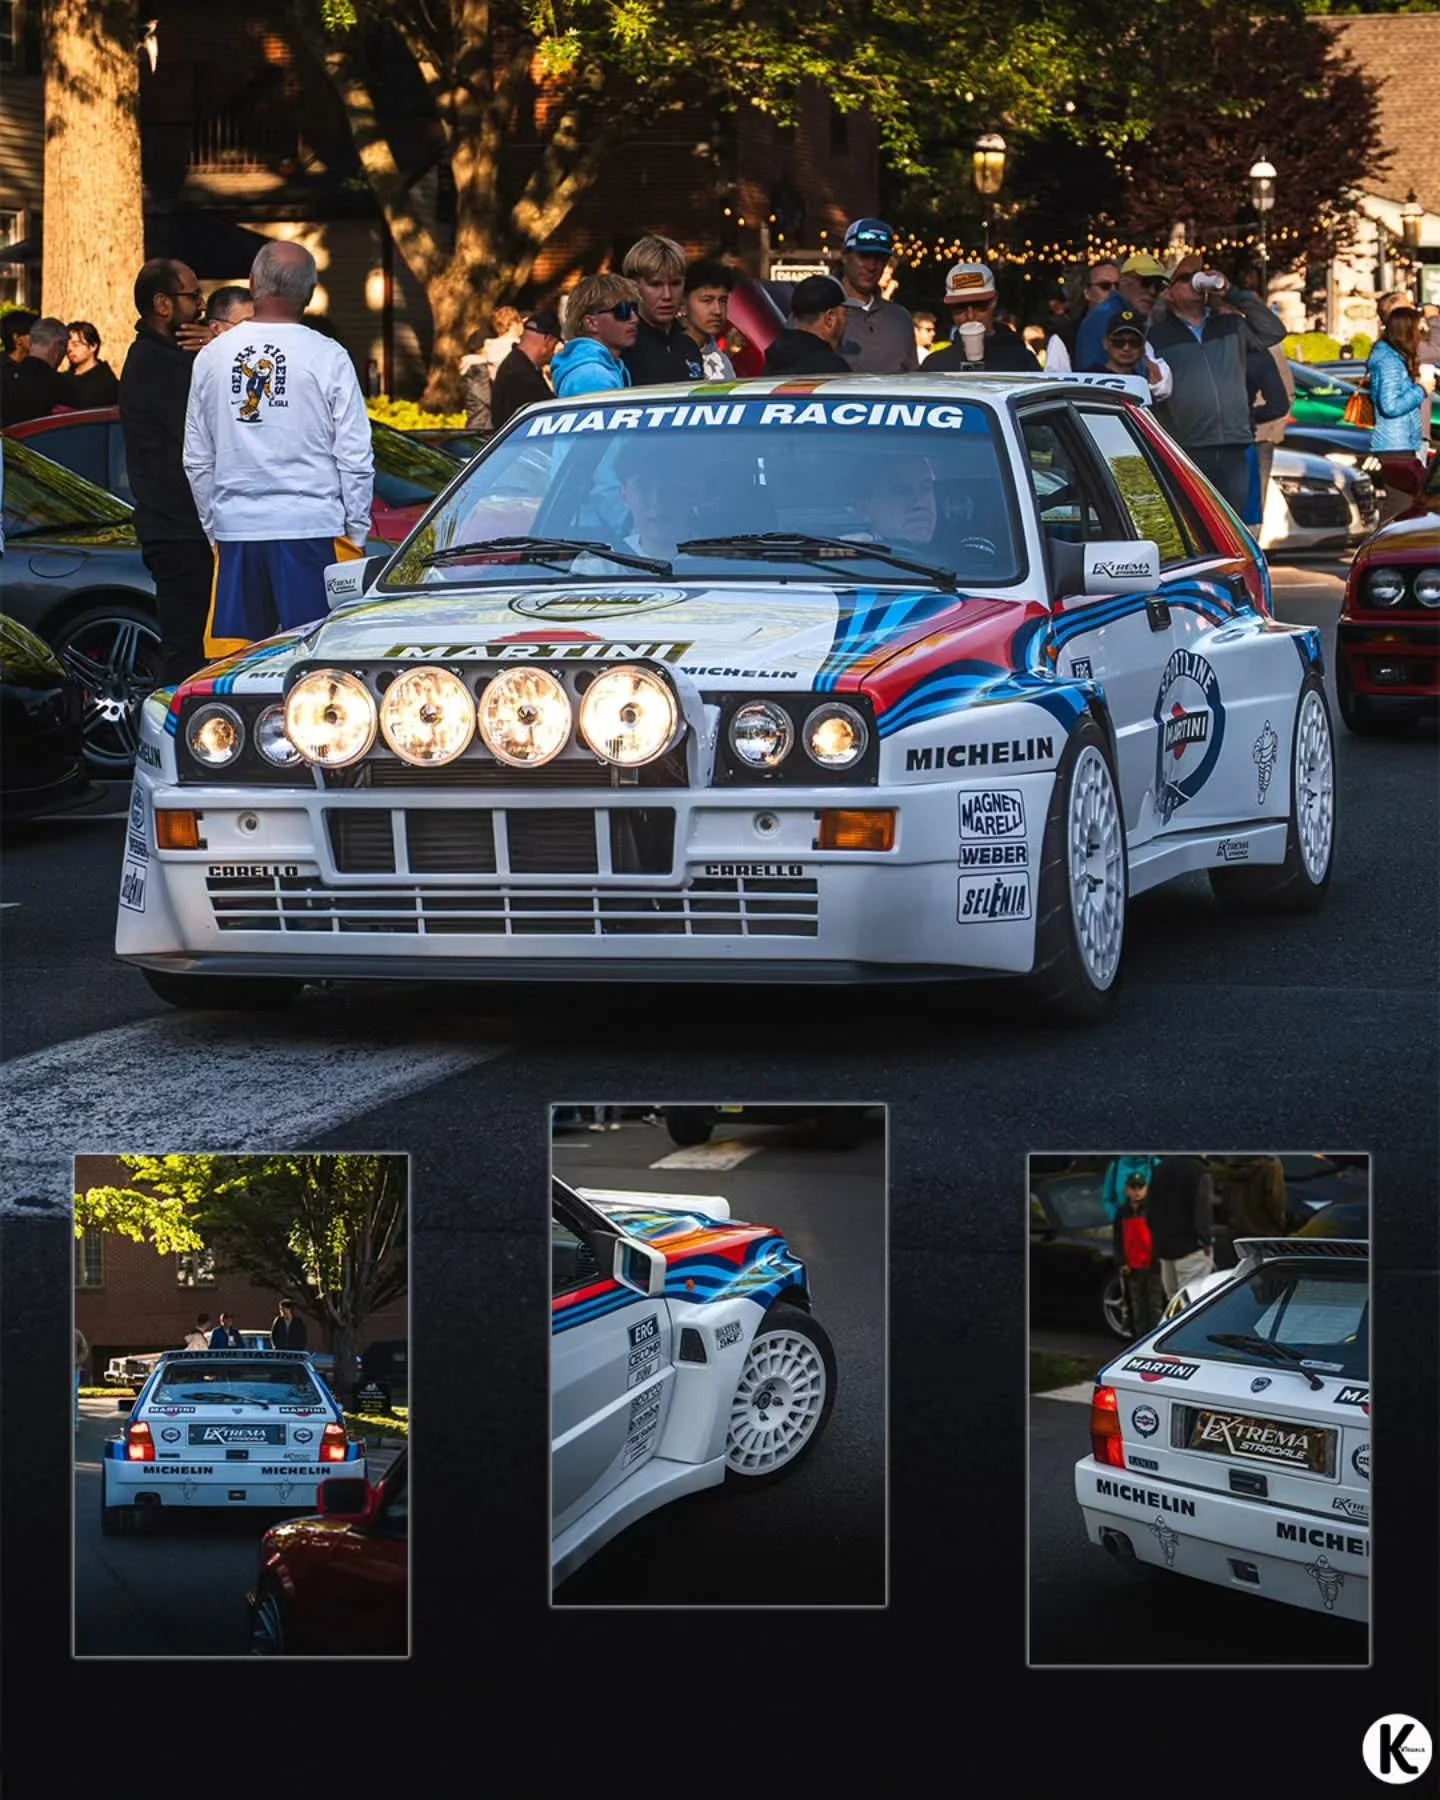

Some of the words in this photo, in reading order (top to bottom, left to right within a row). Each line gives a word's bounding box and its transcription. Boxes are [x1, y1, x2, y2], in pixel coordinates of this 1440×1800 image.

[263, 344, 287, 395] TIGERS
[526, 404, 743, 437] MARTINI
[759, 403, 964, 429] RACING
[397, 644, 677, 661] MARTINI
[1166, 716, 1207, 748] MARTINI
[905, 736, 1054, 771] MICHELIN
[962, 845, 1027, 865] WEBER
[208, 865, 298, 877] CARELLO
[705, 864, 802, 876] CARELLO
[635, 1319, 654, 1343] ERG
[1127, 1359, 1195, 1377] MARTINI
[203, 1426, 267, 1442] EXTREMA
[1201, 1414, 1309, 1449] EXTREMA
[1239, 1440, 1307, 1460] STRADALE
[143, 1465, 214, 1475] MICHELIN
[261, 1466, 331, 1476] MICHELIN
[1096, 1478, 1196, 1517] MICHELIN
